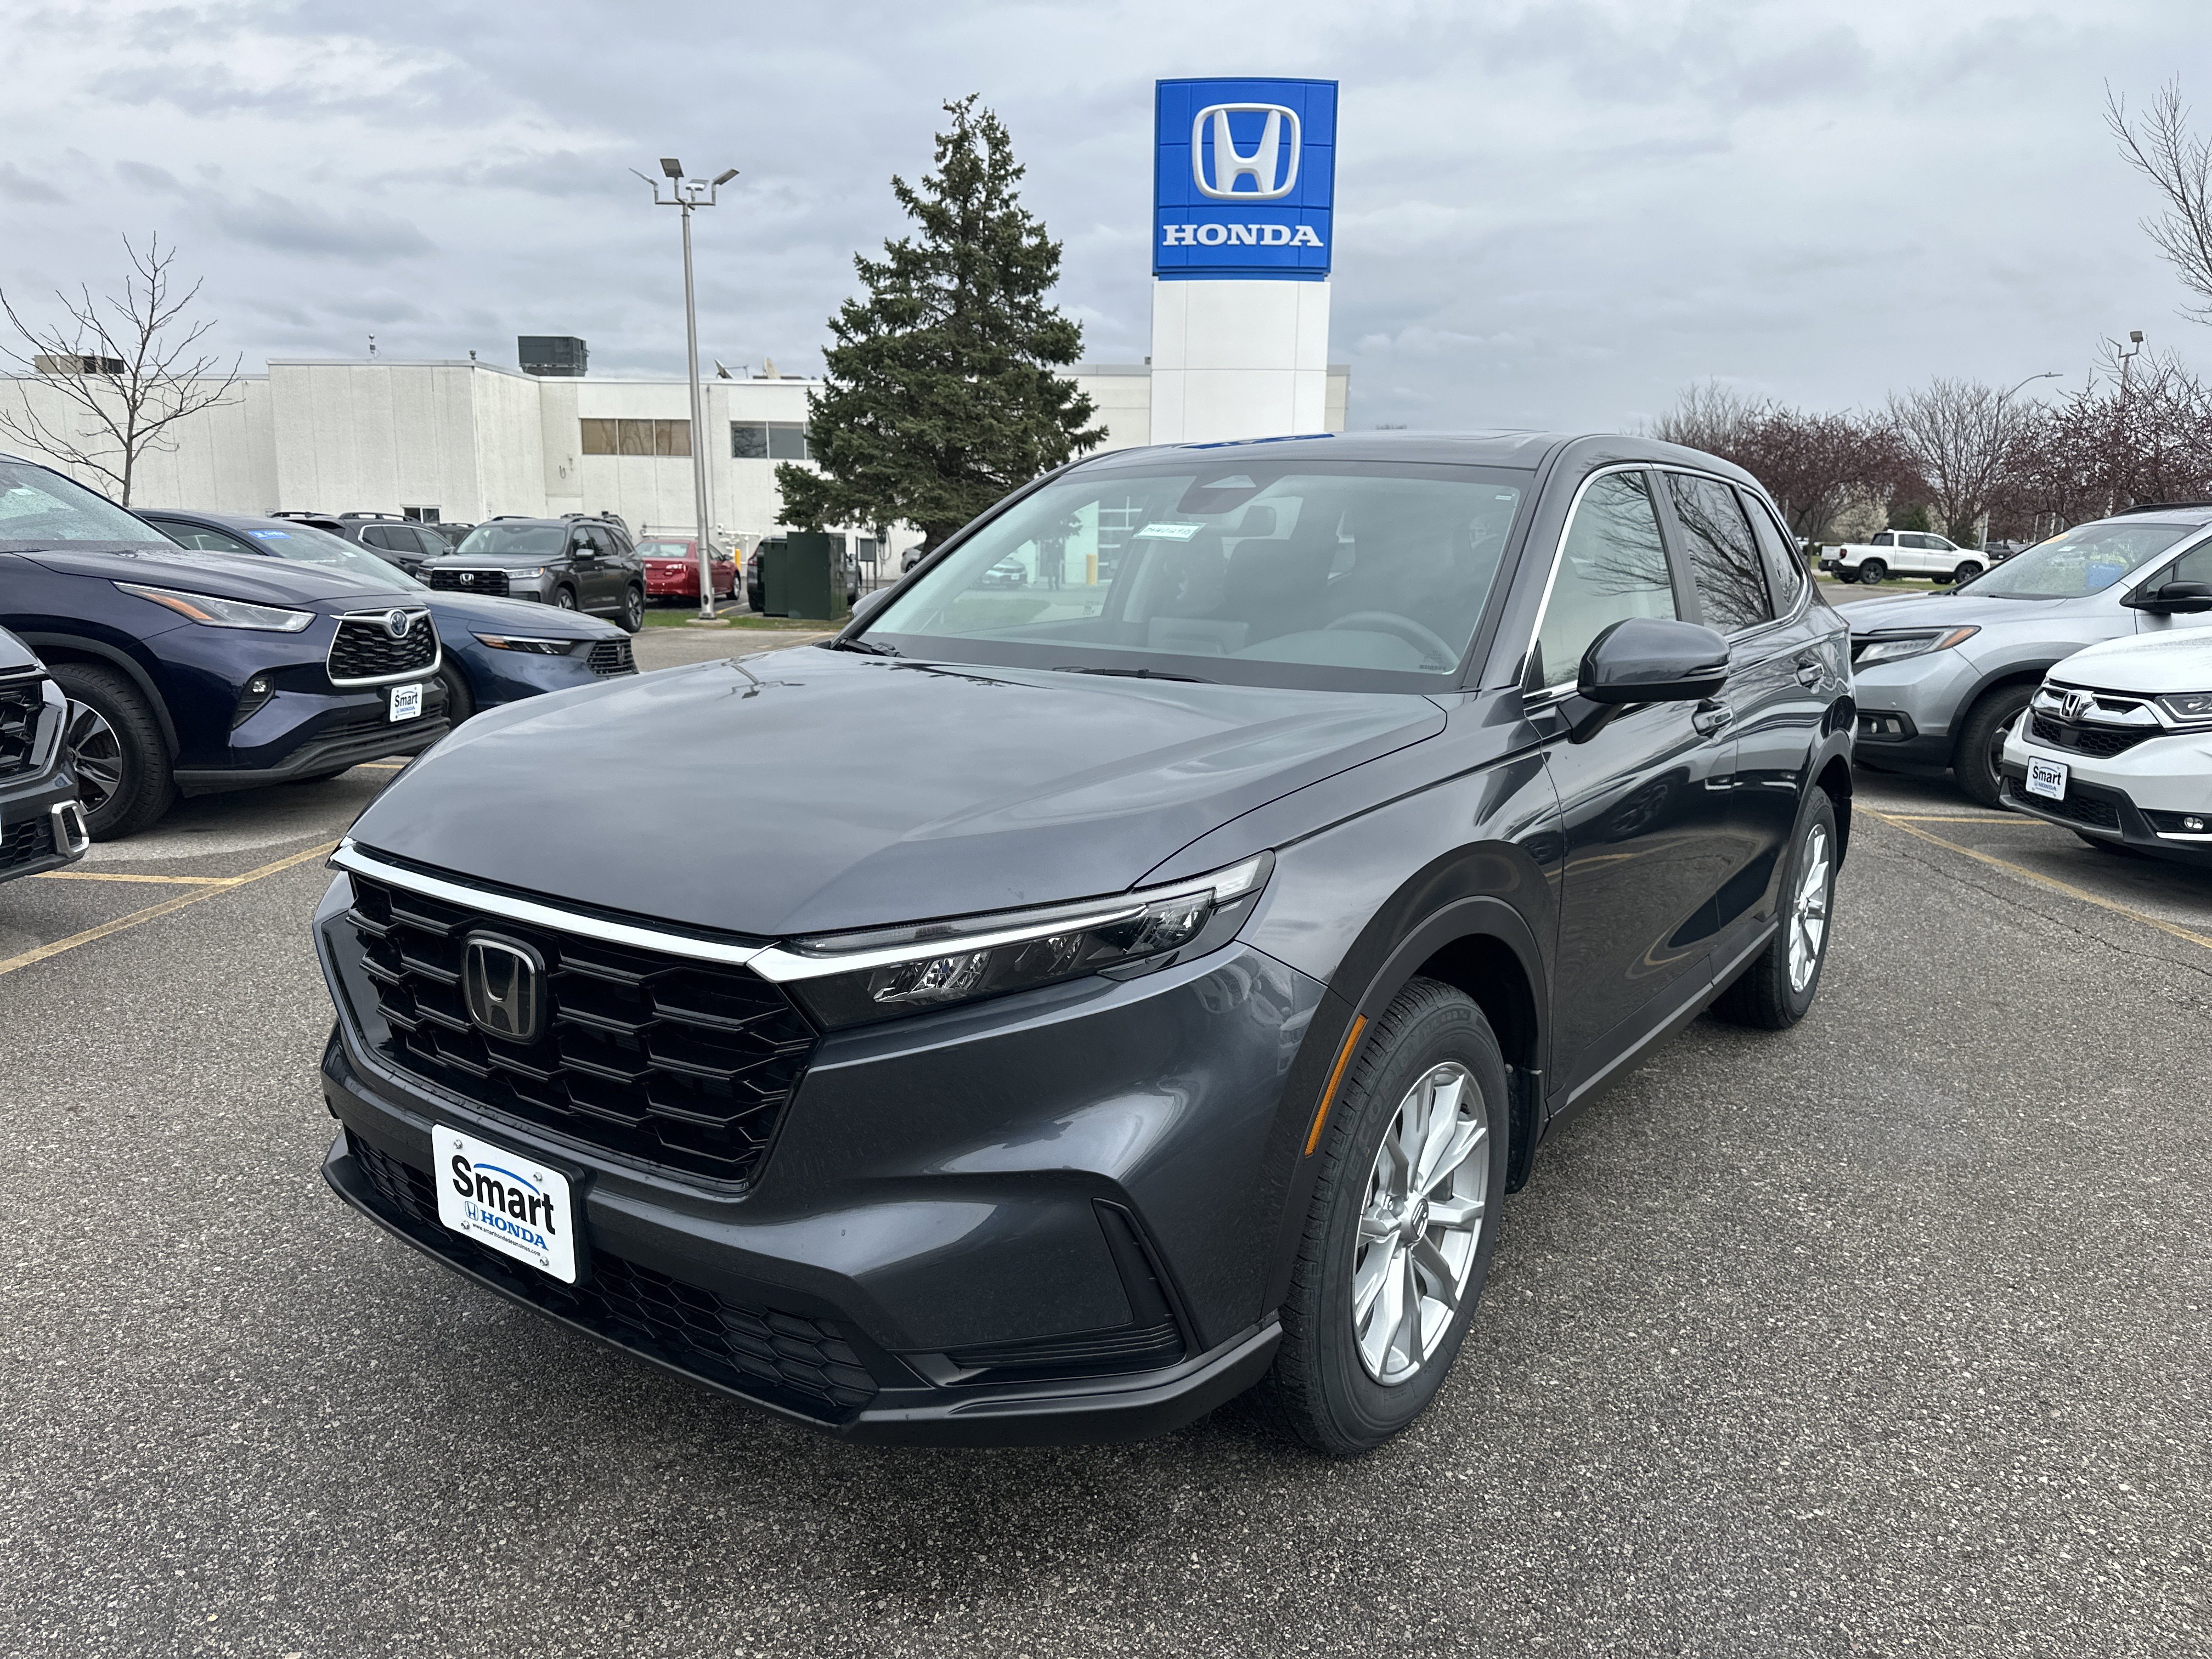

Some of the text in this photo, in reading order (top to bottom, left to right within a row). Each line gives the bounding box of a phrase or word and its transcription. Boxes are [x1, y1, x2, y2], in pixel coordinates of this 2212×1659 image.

[1162, 223, 1324, 247] HONDA
[394, 692, 417, 708] Smart
[2033, 765, 2062, 785] Smart
[452, 1154, 556, 1235] Smart
[480, 1209, 549, 1251] HONDA
